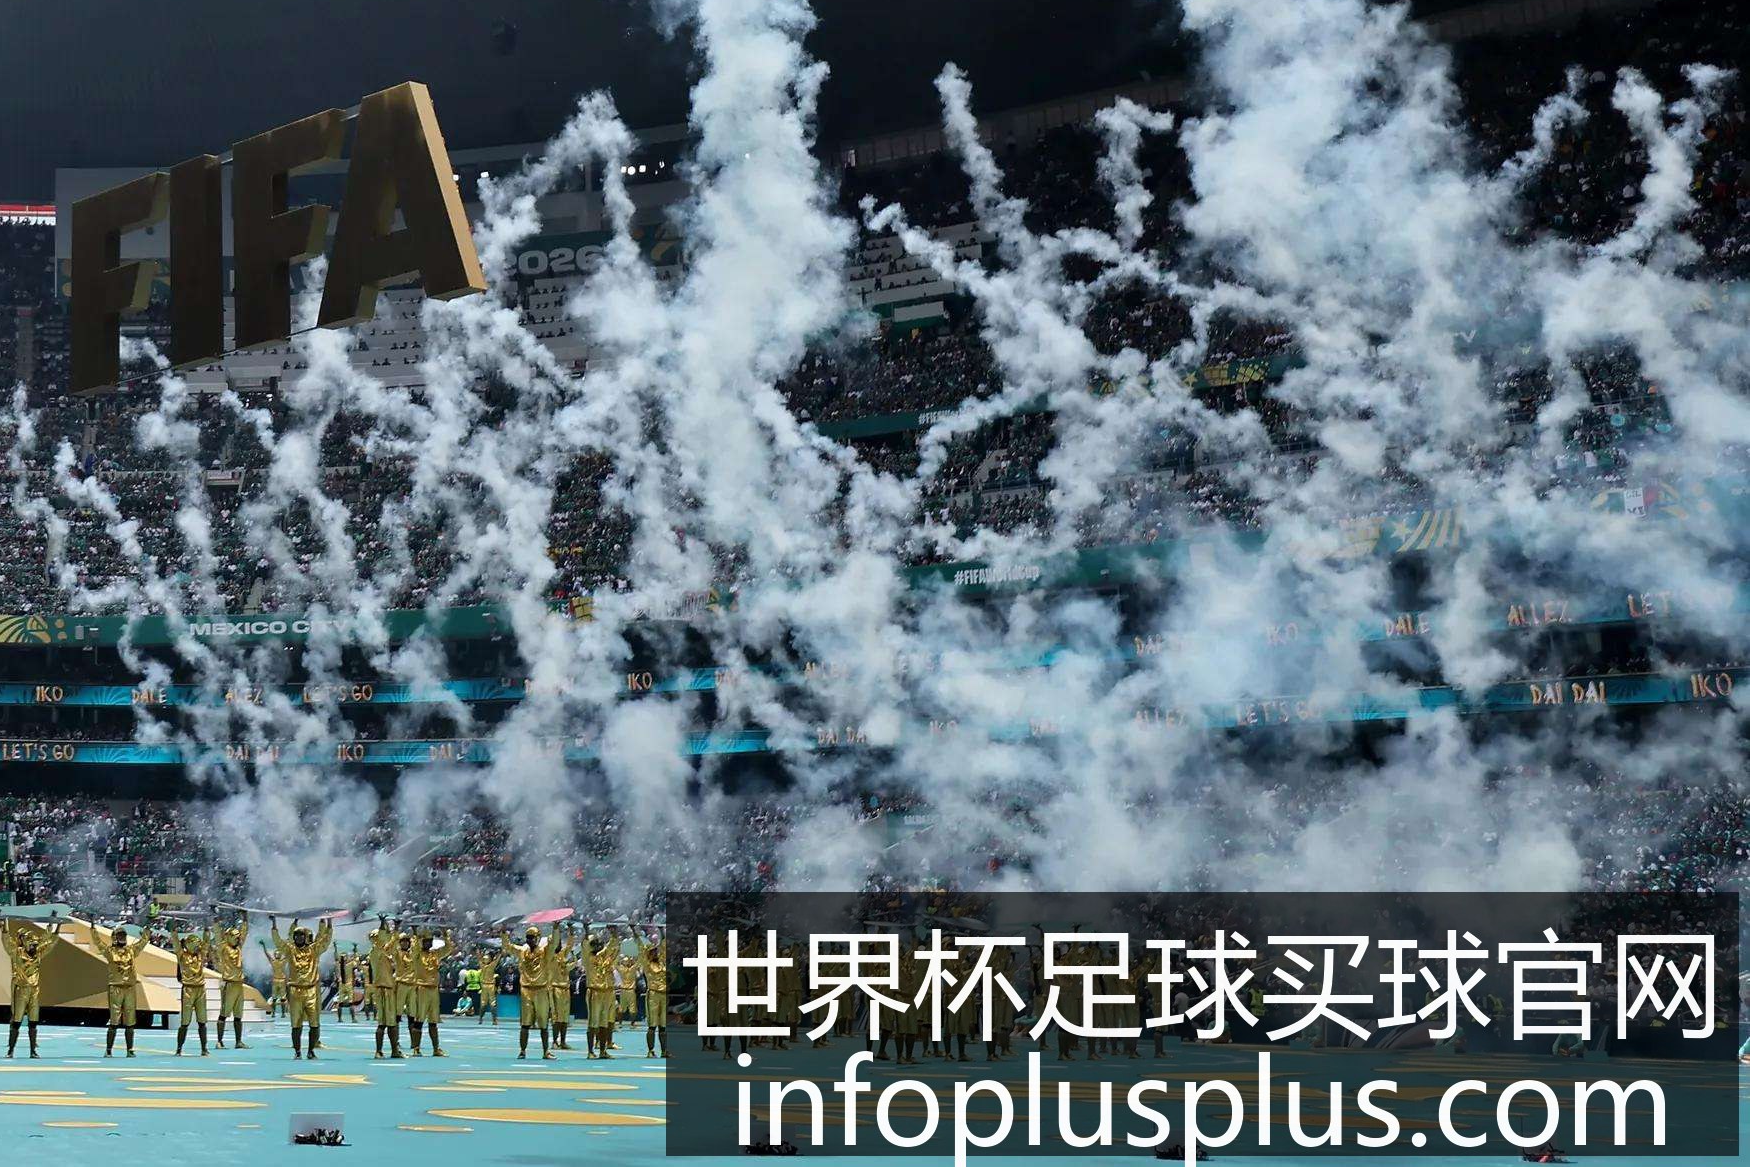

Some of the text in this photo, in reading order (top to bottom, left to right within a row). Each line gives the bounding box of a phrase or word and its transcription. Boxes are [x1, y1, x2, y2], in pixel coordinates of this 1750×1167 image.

[71, 81, 487, 395] FIFA
[190, 621, 287, 636] MEXICO
[628, 671, 653, 691] IKO
[1690, 672, 1732, 698] IKO
[36, 685, 63, 703] IKO
[351, 684, 372, 702] GO
[1530, 681, 1607, 705] DAI DAI
[2, 742, 75, 761] LET'S GO
[338, 744, 364, 761] IKO
